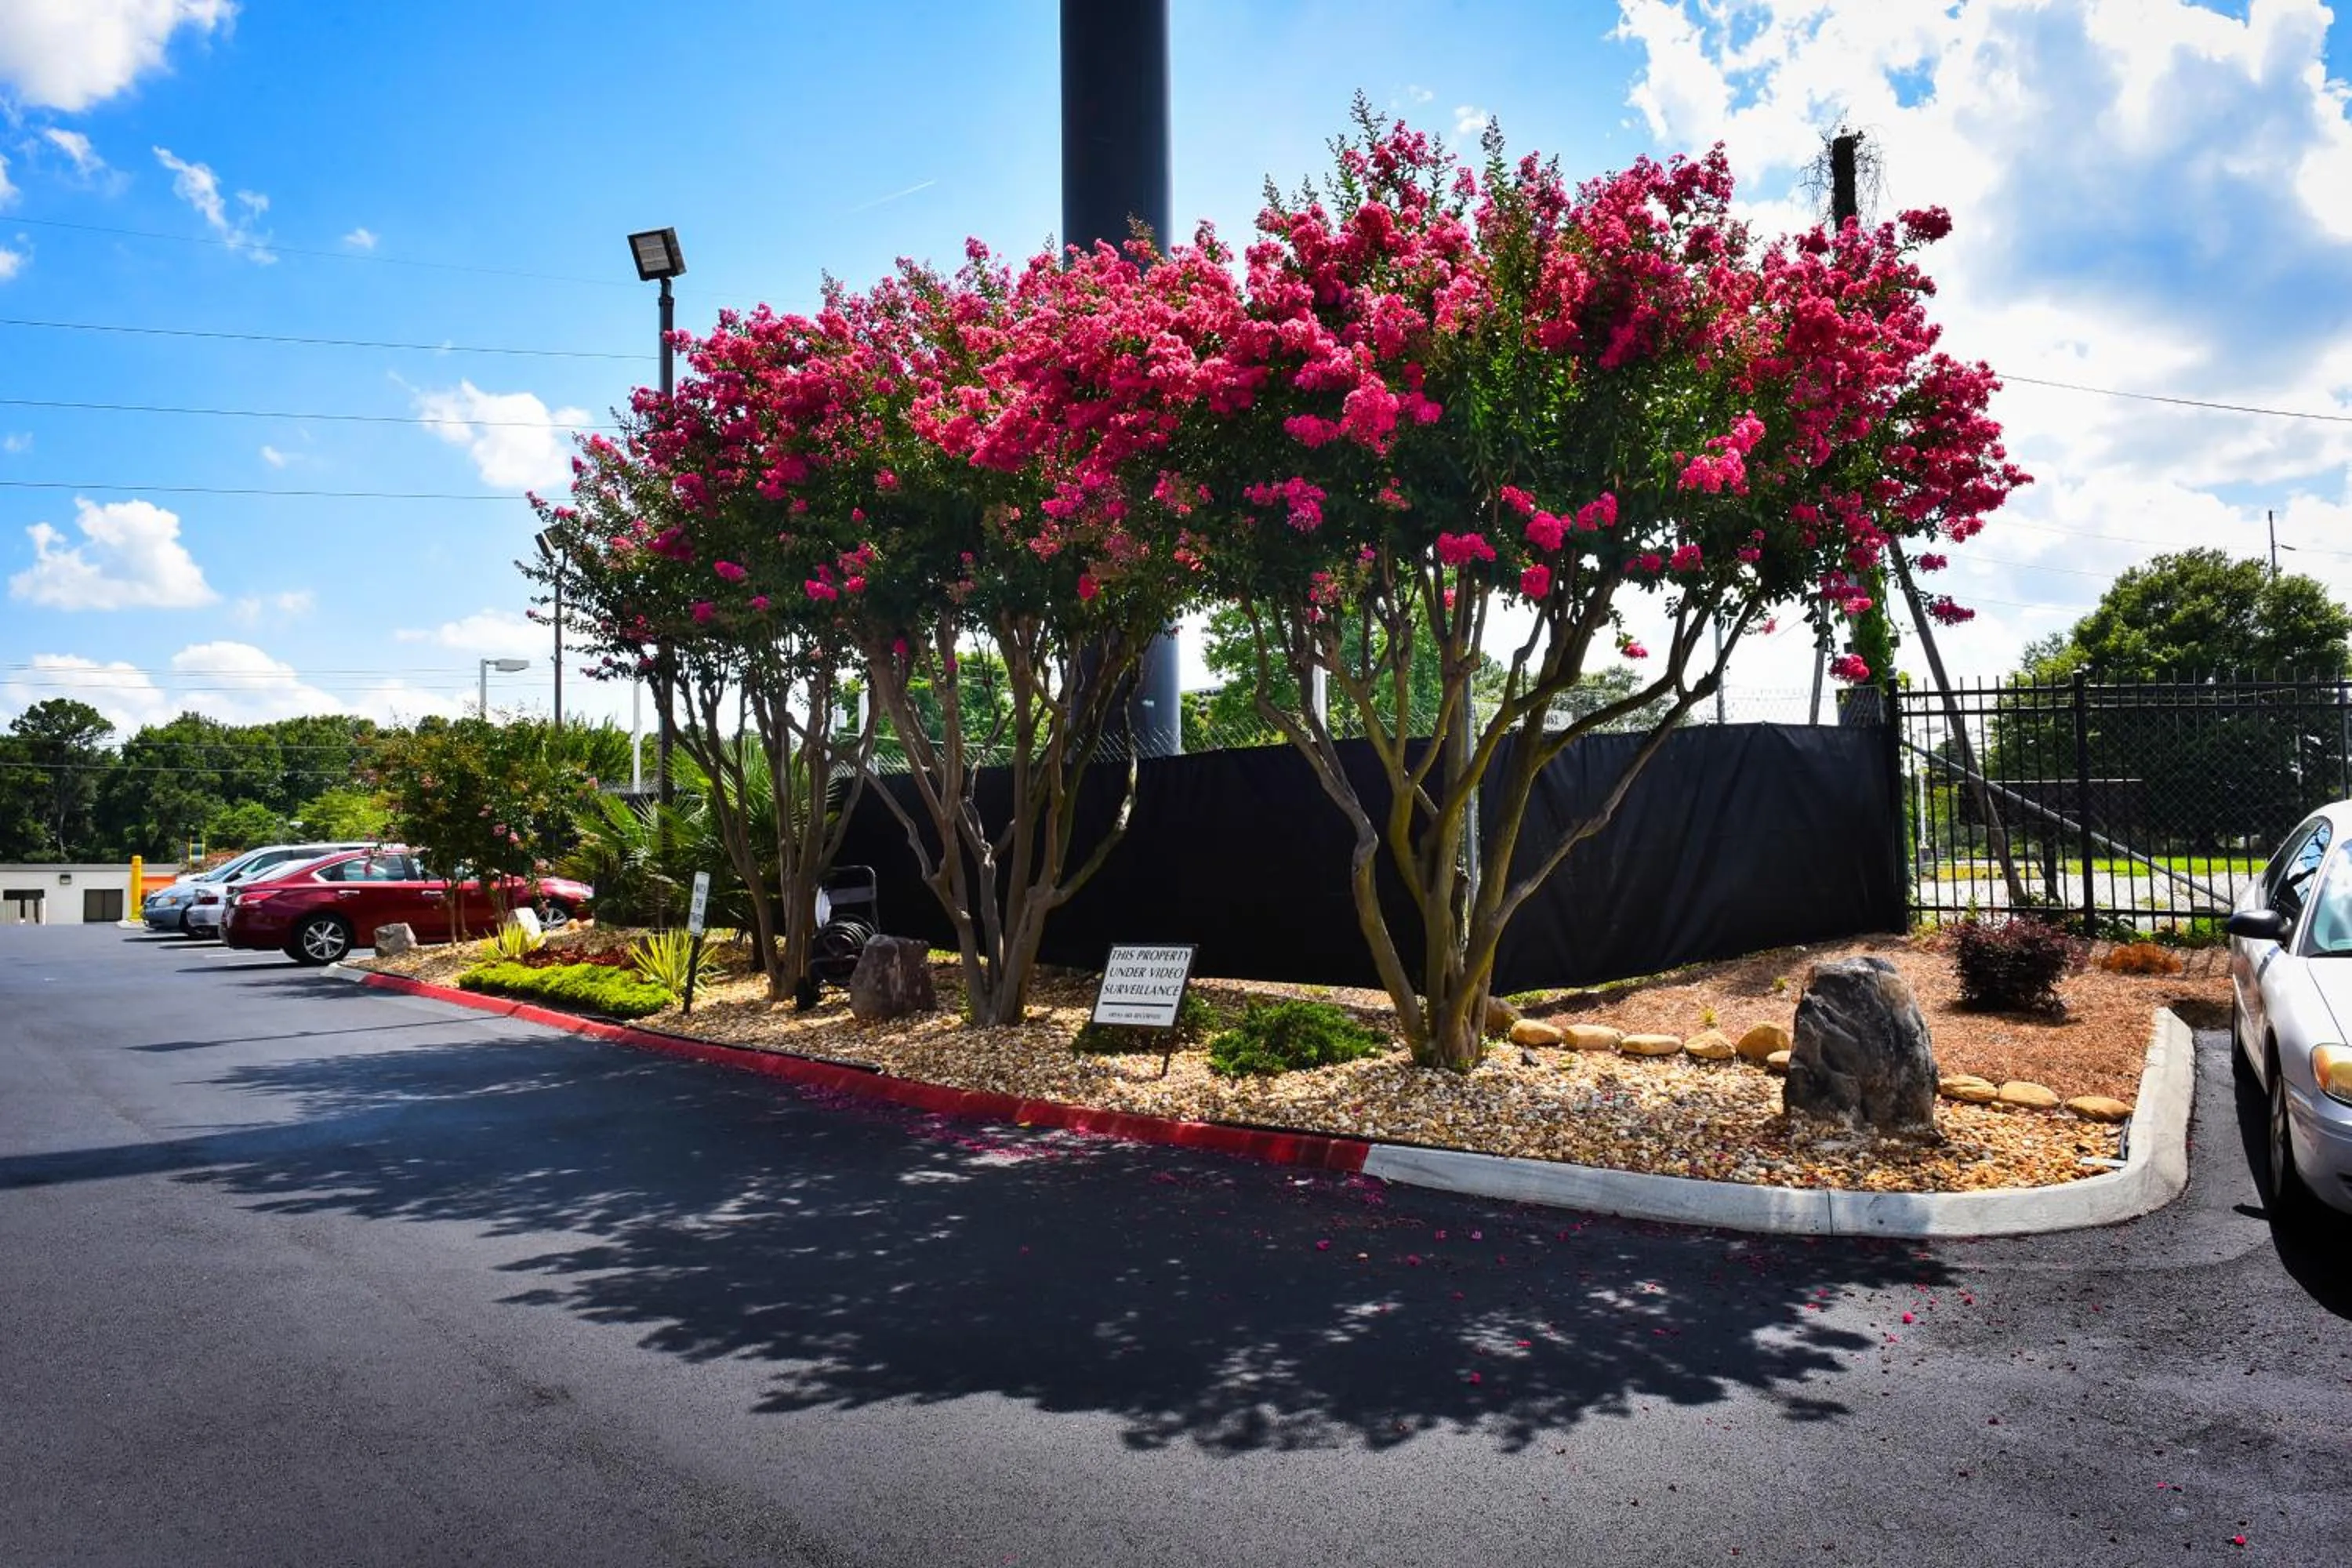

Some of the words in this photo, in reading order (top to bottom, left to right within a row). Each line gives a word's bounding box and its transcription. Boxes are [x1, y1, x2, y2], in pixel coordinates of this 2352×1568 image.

[1112, 950, 1135, 960] THIS
[1137, 950, 1189, 961] PROPERTY
[1110, 967, 1146, 978] UNDER
[1149, 967, 1184, 978] VIDEO
[1104, 984, 1181, 996] SURVEILLANCE
